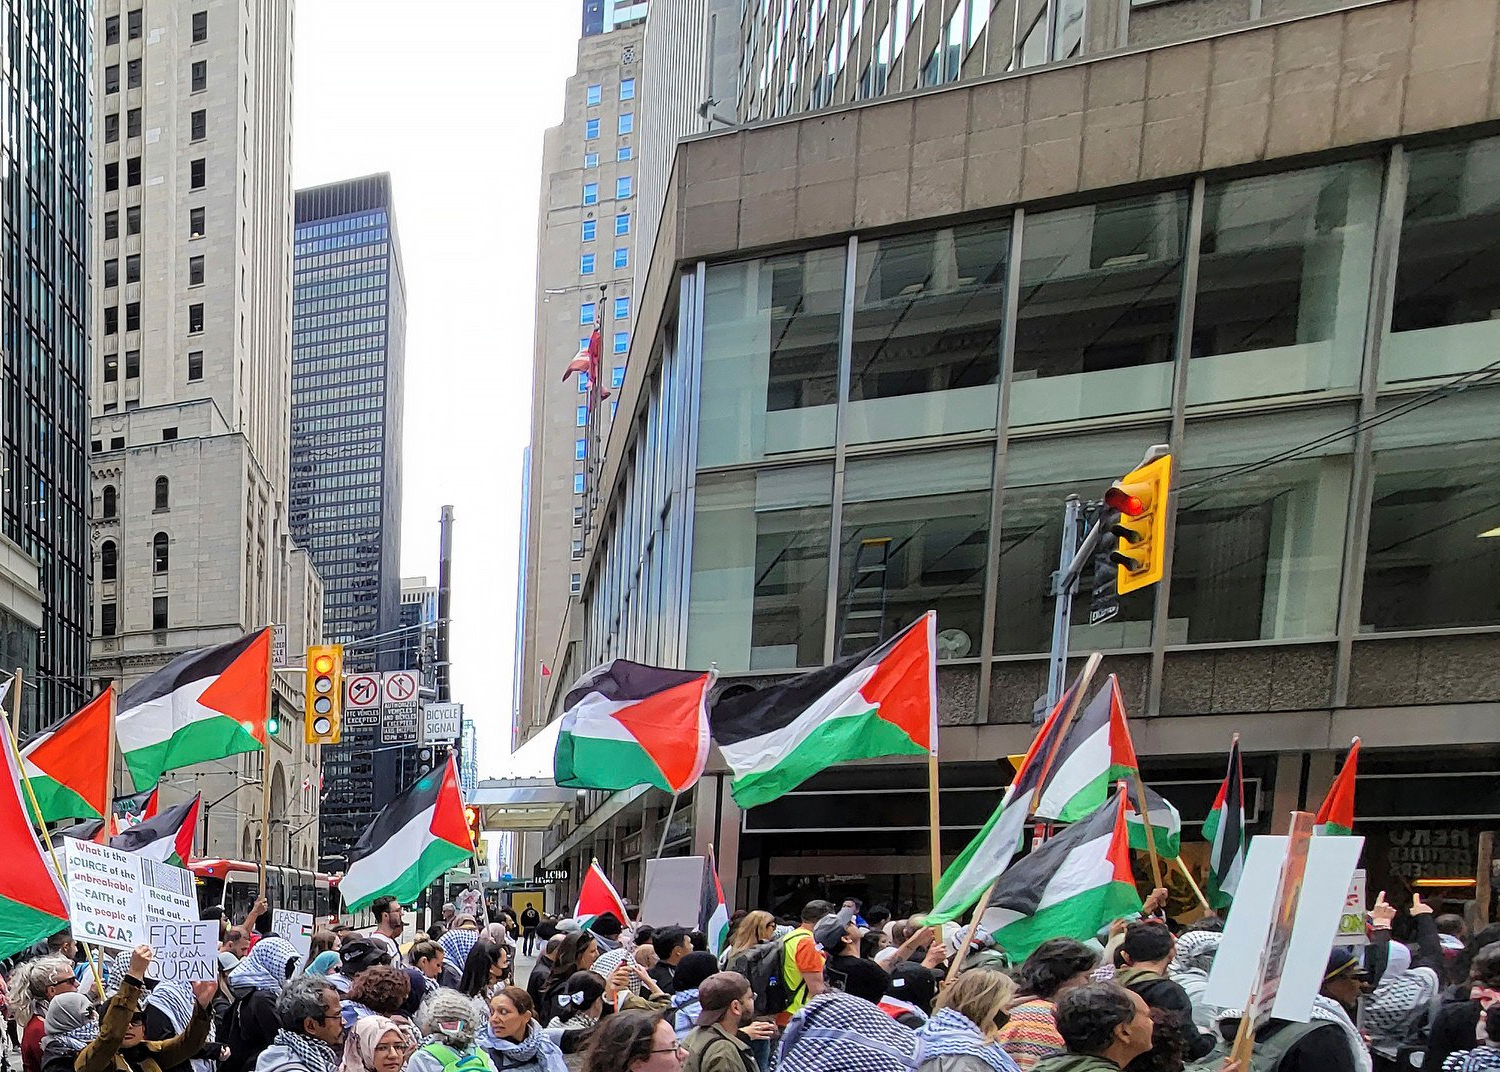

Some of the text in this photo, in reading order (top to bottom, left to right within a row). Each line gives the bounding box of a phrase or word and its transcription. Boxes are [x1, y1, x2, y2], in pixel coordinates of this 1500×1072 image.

[426, 708, 457, 720] BICYCLE
[426, 722, 456, 733] SIGNAL
[75, 842, 127, 863] What is the
[110, 867, 118, 876] of
[120, 869, 136, 880] the
[74, 873, 133, 894] unbreakable
[85, 888, 126, 906] FAITH of
[149, 889, 190, 908] Read and
[76, 902, 92, 913] the
[94, 907, 126, 920] people
[127, 914, 137, 923] of
[147, 904, 165, 916] find
[274, 910, 301, 924] CEASE
[85, 921, 133, 943] GAZA?
[273, 920, 291, 933] FIRE
[150, 924, 207, 946] FREE
[153, 945, 206, 960] English
